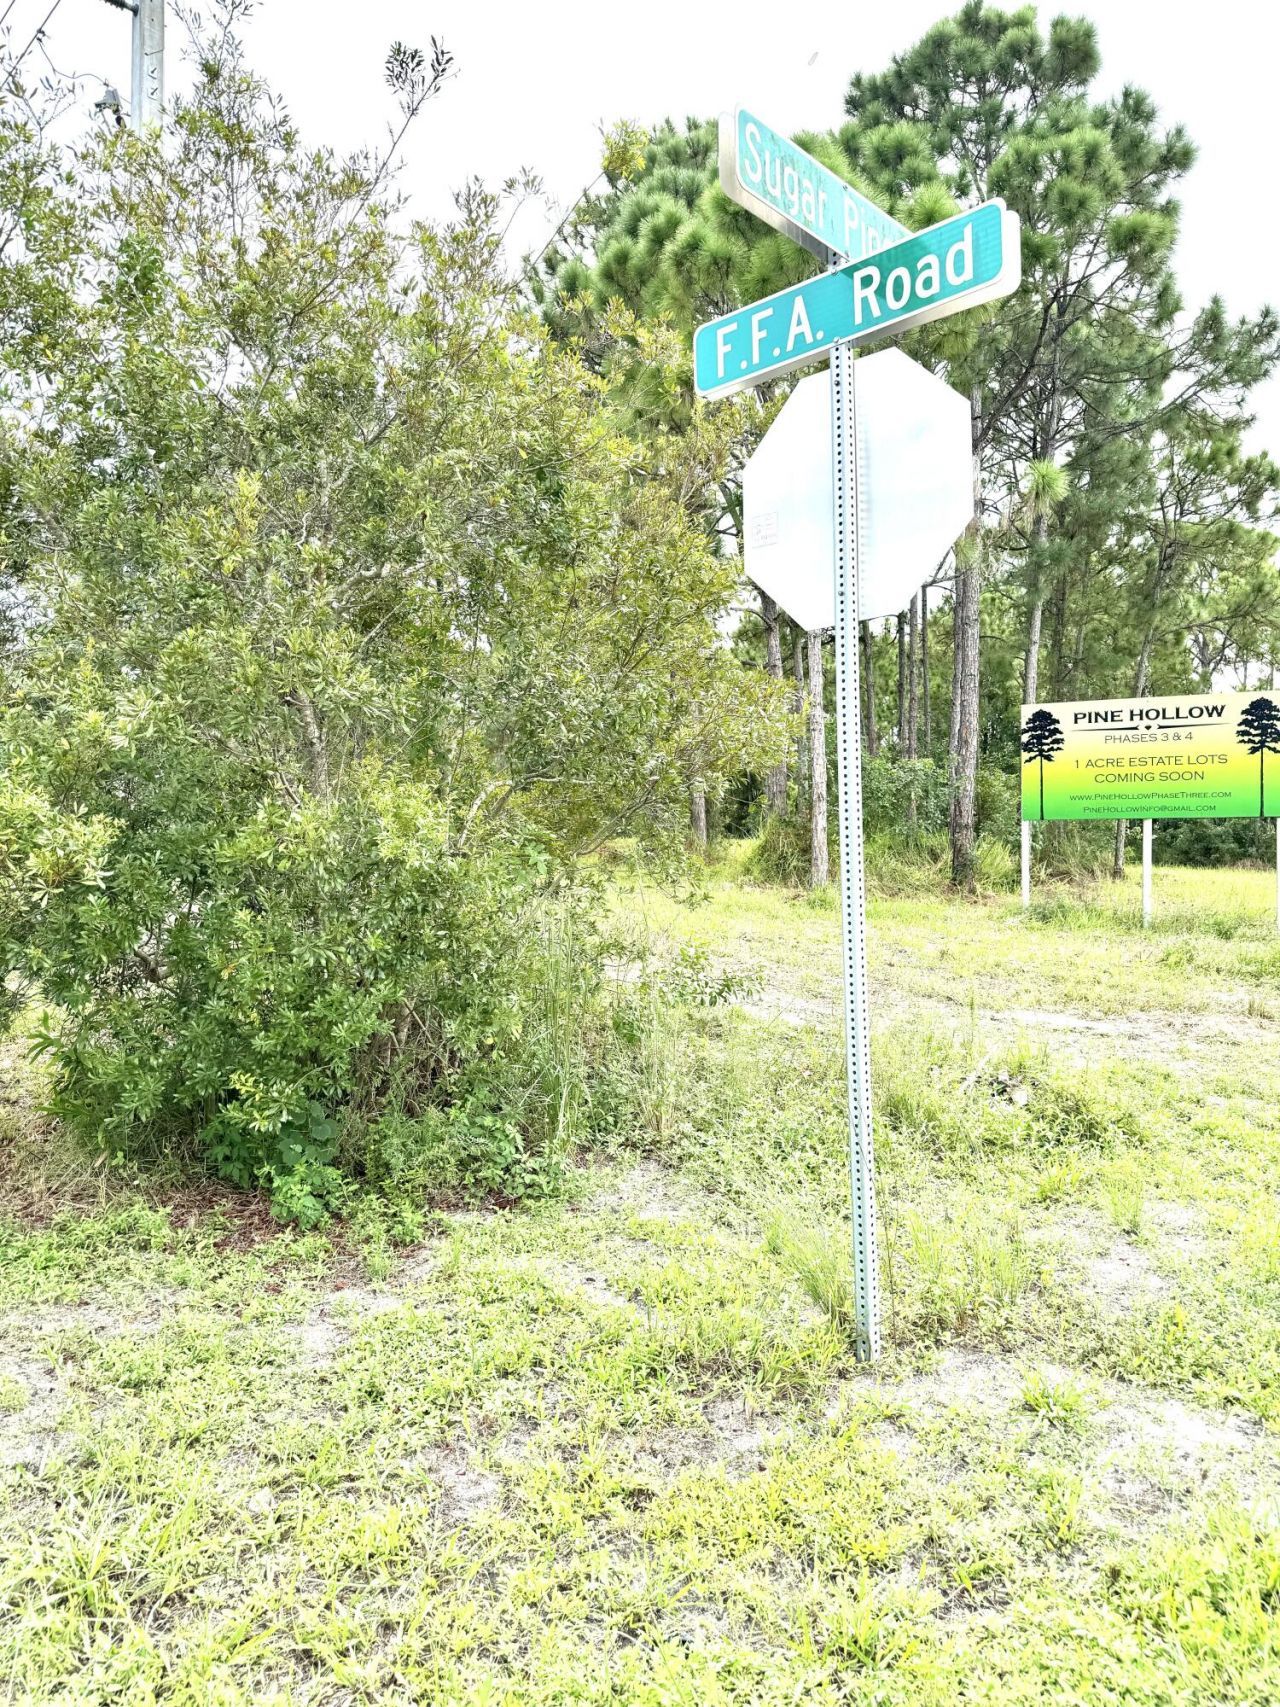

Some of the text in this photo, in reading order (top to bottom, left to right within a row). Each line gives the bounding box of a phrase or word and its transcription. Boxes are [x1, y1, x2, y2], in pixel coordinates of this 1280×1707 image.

[744, 122, 899, 256] Sugar Pin
[716, 221, 974, 379] F.F.A. Road
[1073, 704, 1226, 724] PINE HOLLOW
[1104, 731, 1193, 744] PHASES 3 & 4
[1075, 754, 1228, 769] 1 ACRE ESTATE LOTS
[1094, 771, 1205, 784] COMING SOON
